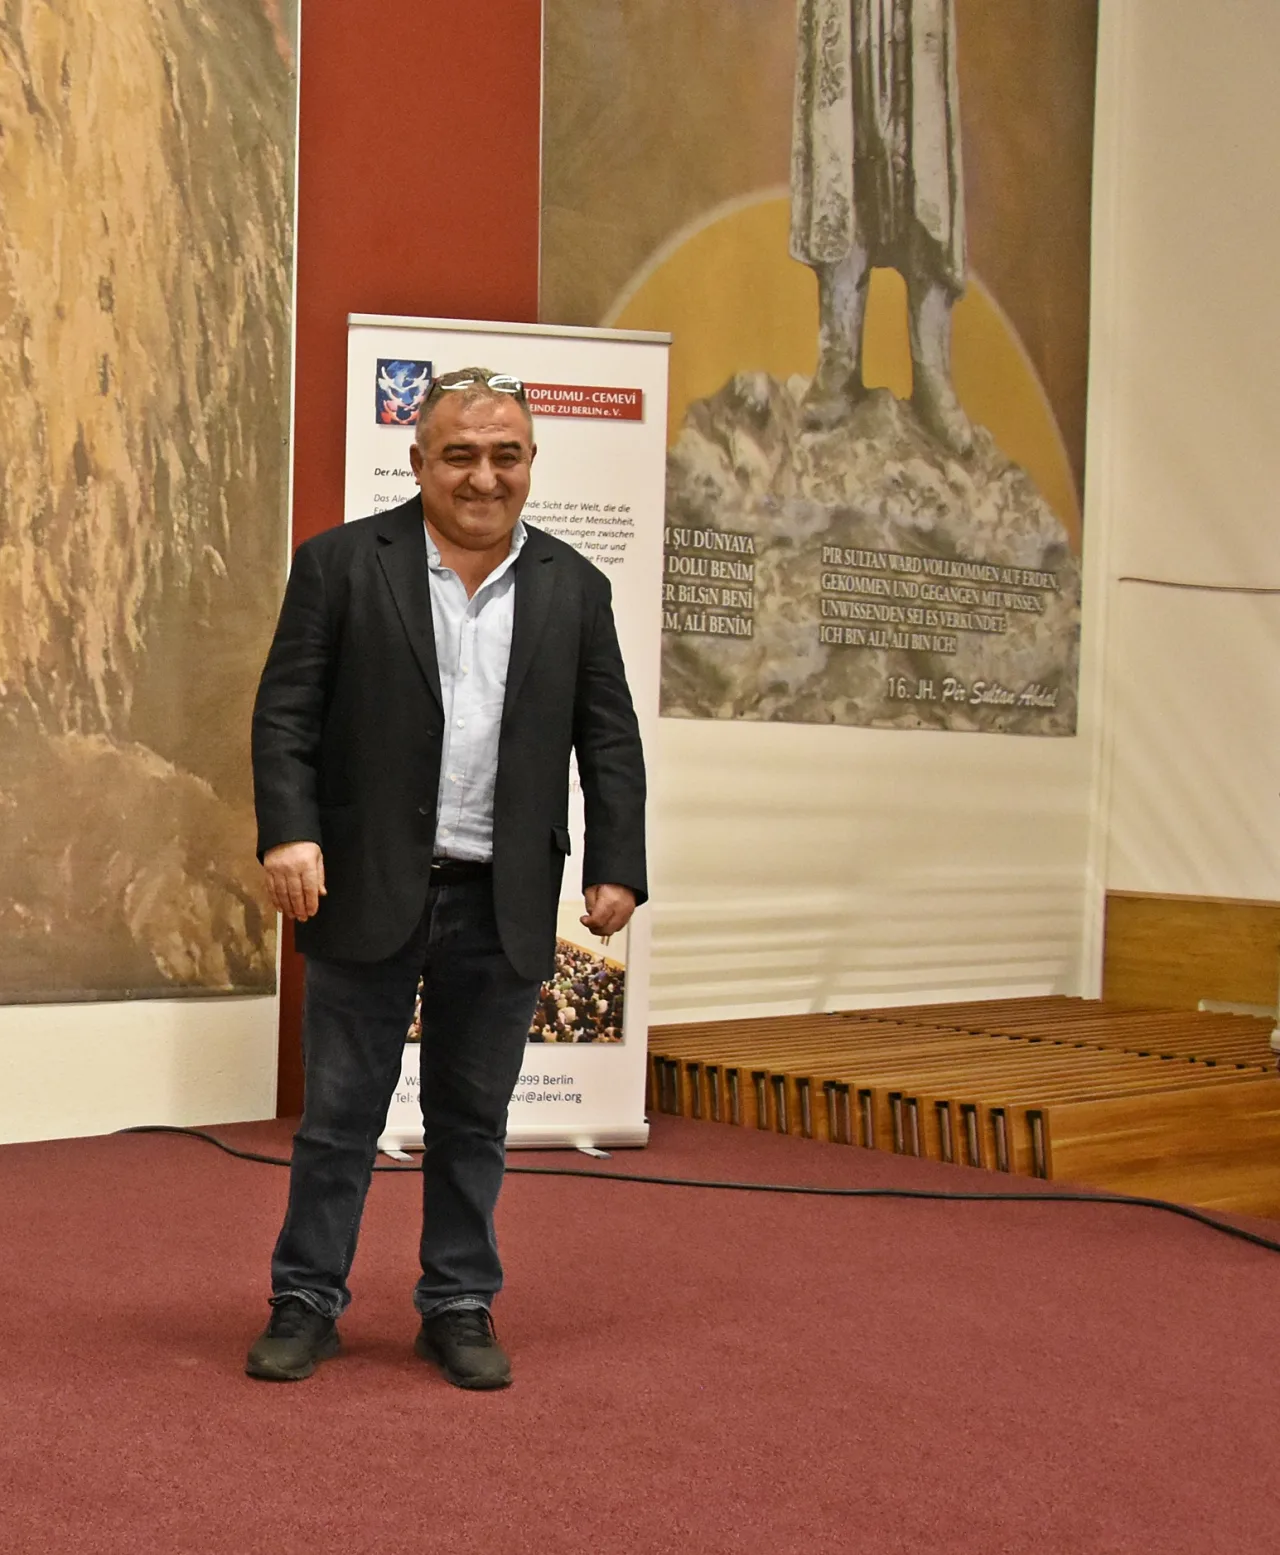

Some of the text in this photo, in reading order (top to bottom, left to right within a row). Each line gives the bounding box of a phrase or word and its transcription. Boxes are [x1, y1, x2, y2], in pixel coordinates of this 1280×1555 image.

[523, 388, 584, 402] TOPLUMU
[591, 391, 637, 405] CEMEVİ
[529, 403, 556, 414] EINDE
[557, 405, 571, 414] ZU
[572, 406, 603, 415] BERLIN
[613, 408, 622, 417] V.
[374, 467, 390, 476] Der
[373, 493, 390, 503] Das
[542, 501, 562, 510] Sicht
[564, 501, 578, 511] der
[580, 503, 601, 512] Welt,
[603, 503, 617, 512] die
[617, 504, 631, 513] die
[520, 514, 635, 527] gangenheit der Menschheit,
[597, 529, 635, 539] zwischen
[672, 527, 692, 550] ŞU
[693, 528, 755, 554] DÜNYAYA
[584, 541, 609, 551] Natur
[610, 542, 627, 551] und
[595, 554, 625, 565] Fragen
[822, 545, 843, 564] PIR
[844, 548, 887, 569] SULTAN
[888, 553, 922, 573] WARD
[923, 557, 1000, 581] VOLLKOMMEN
[1000, 568, 1021, 585] AUF
[668, 555, 754, 581] DOLU BENİM
[821, 572, 891, 596] GEKOMMEN
[892, 579, 919, 599] UND
[920, 582, 980, 605] GEGANGEN
[981, 589, 1002, 608] MIT
[721, 588, 753, 609] BENİ
[821, 598, 906, 623] UNWISSENDEN
[906, 607, 924, 625] SEI
[925, 609, 939, 626] ES
[683, 612, 706, 632] ALİ
[709, 614, 753, 636] BENİM
[820, 625, 843, 644] ICH
[844, 627, 866, 646] BIN
[866, 630, 890, 650] ALI,
[890, 632, 909, 649] ALI
[911, 633, 931, 651] BIN
[887, 676, 911, 699] 16.
[914, 678, 937, 700] JH.
[941, 677, 967, 702] Pir
[969, 681, 1016, 705] Sultan
[543, 1074, 574, 1085] Berlin
[394, 1091, 414, 1103] Tel:
[509, 1090, 583, 1104] evi@alevi.org
